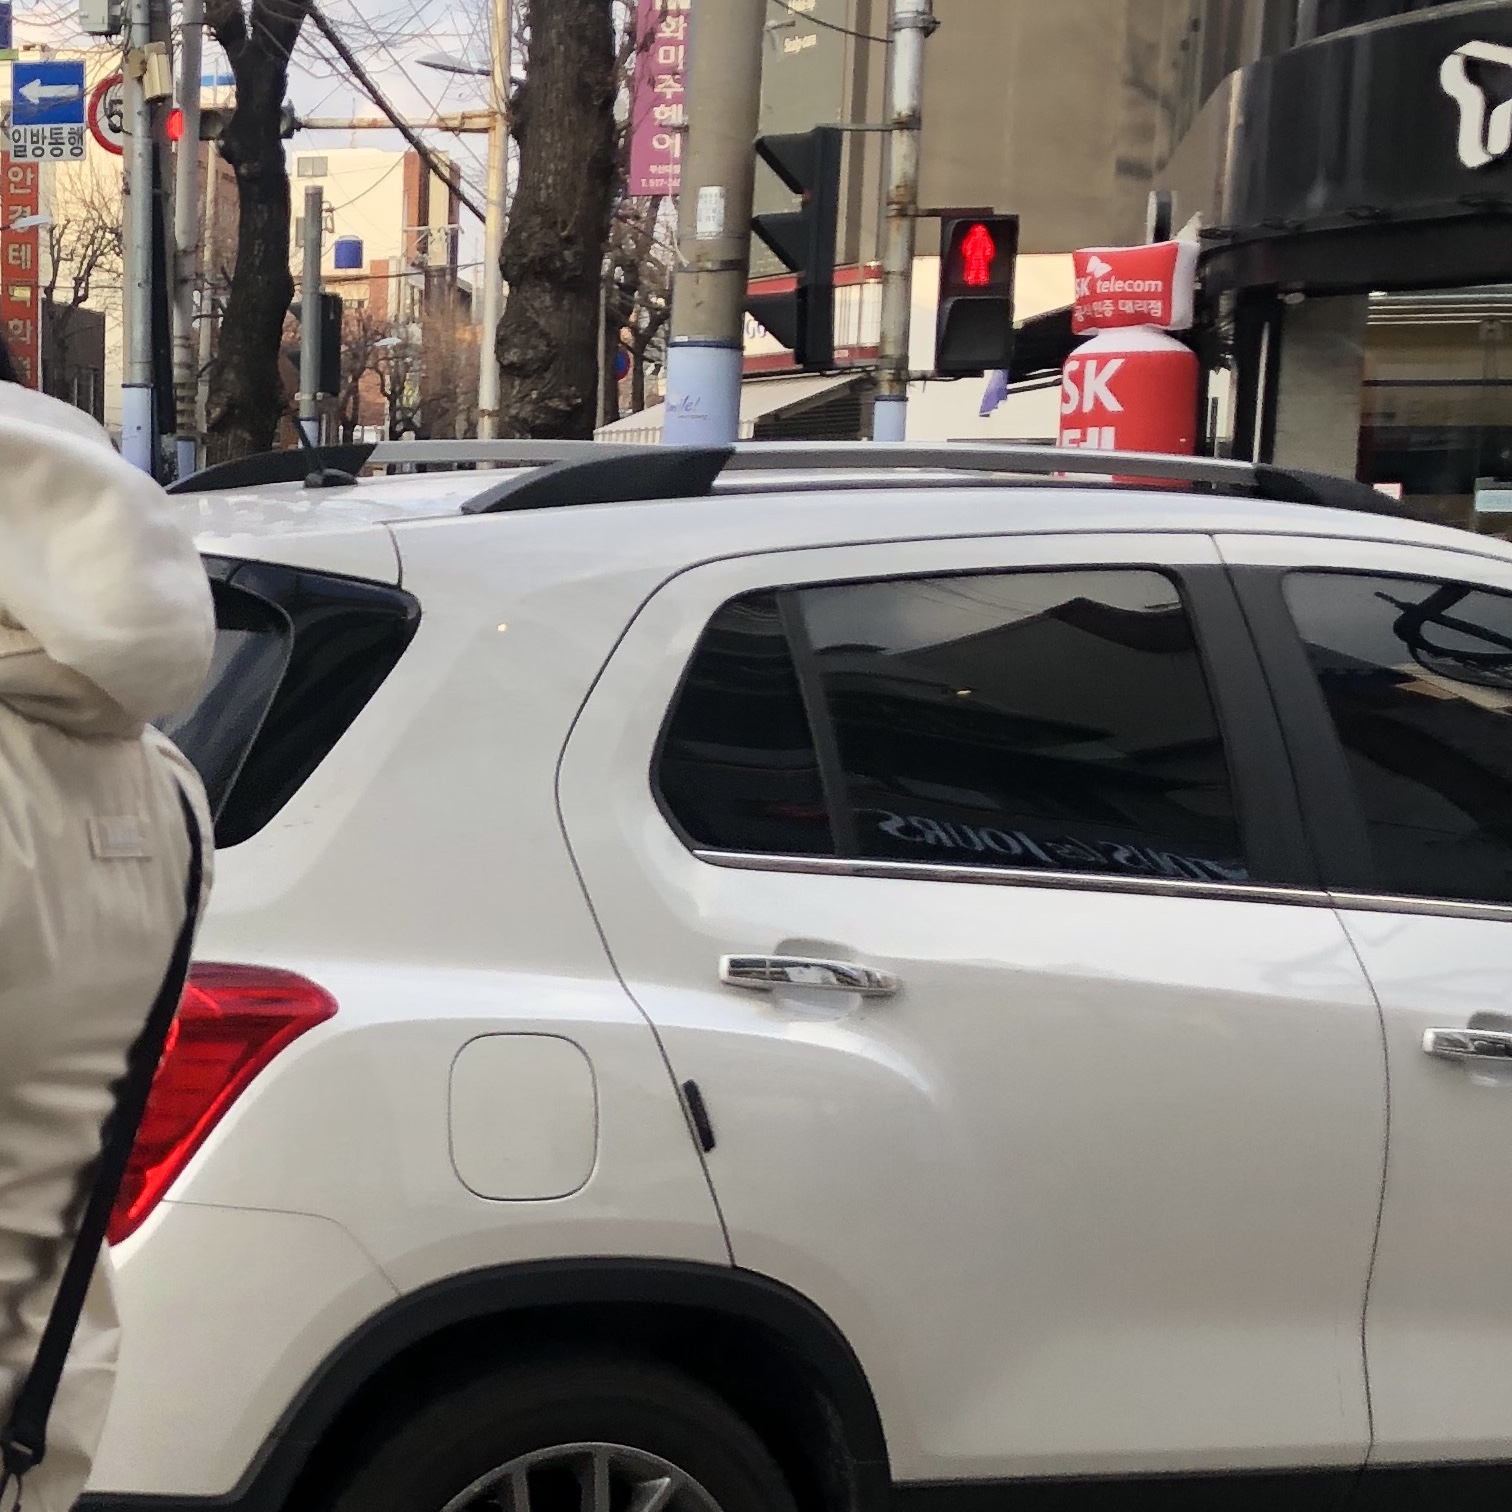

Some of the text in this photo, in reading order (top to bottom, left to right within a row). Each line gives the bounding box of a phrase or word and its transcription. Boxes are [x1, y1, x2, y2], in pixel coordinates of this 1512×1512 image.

[652, 15, 688, 158] 화미주헤어
[11, 125, 84, 159] 일방통행
[1074, 275, 1163, 296] SK telecom
[1118, 299, 1162, 318] 대리점
[1061, 357, 1127, 416] SK
